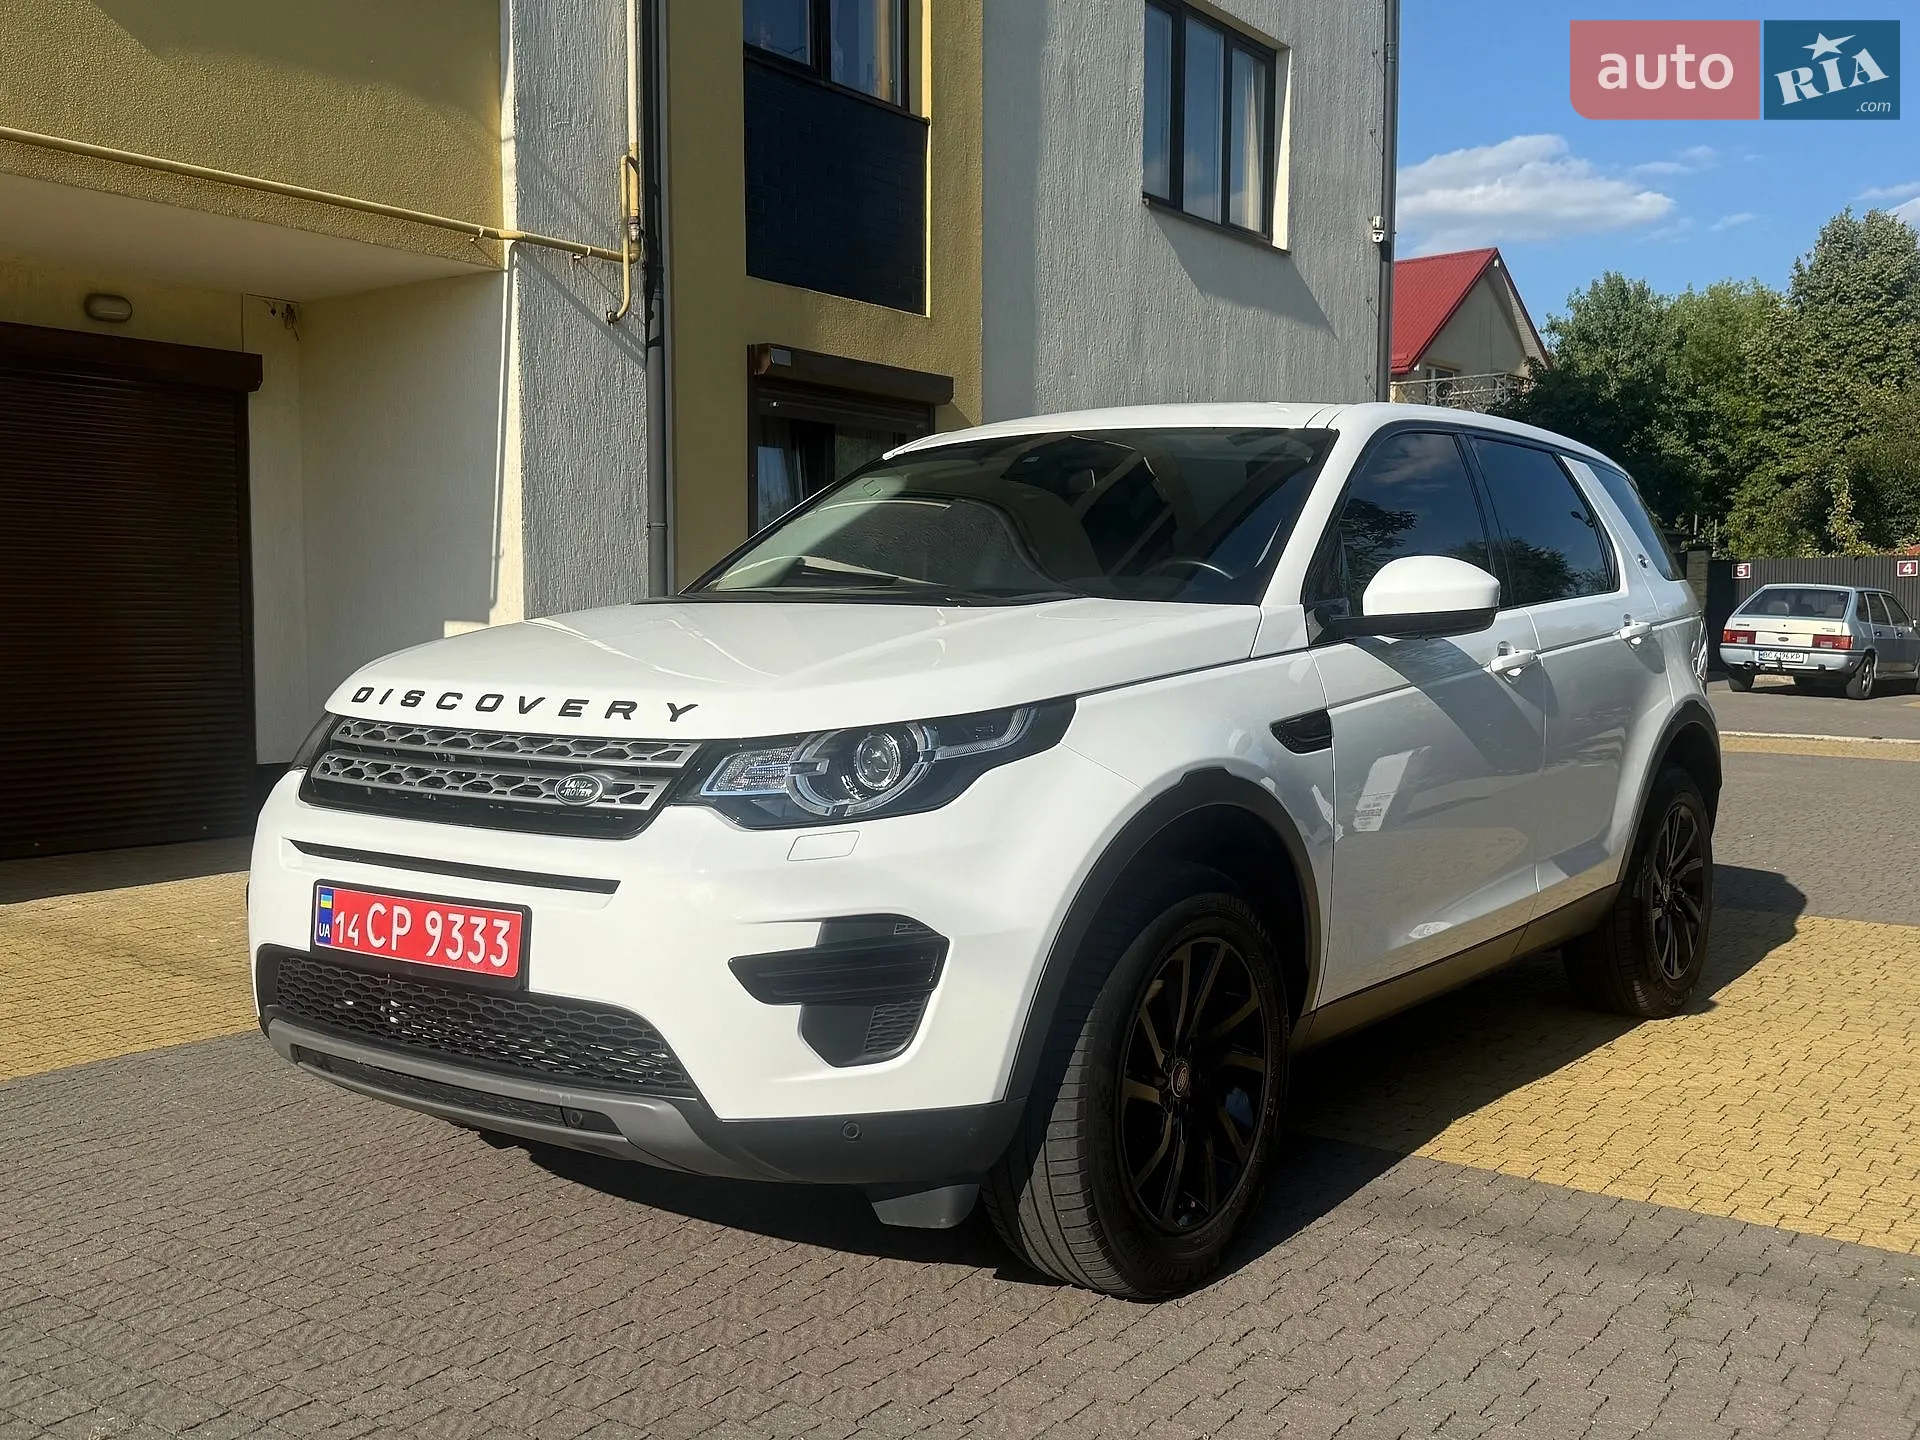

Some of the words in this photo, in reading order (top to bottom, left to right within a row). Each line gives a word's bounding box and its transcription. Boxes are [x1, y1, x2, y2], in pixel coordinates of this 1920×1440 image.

[1736, 565, 1746, 577] 5
[1902, 562, 1912, 575] 4
[351, 686, 698, 723] DISCOVERY
[564, 779, 588, 789] LAND
[563, 788, 593, 797] ROVER
[318, 922, 331, 938] UA
[424, 910, 511, 968] 9333
